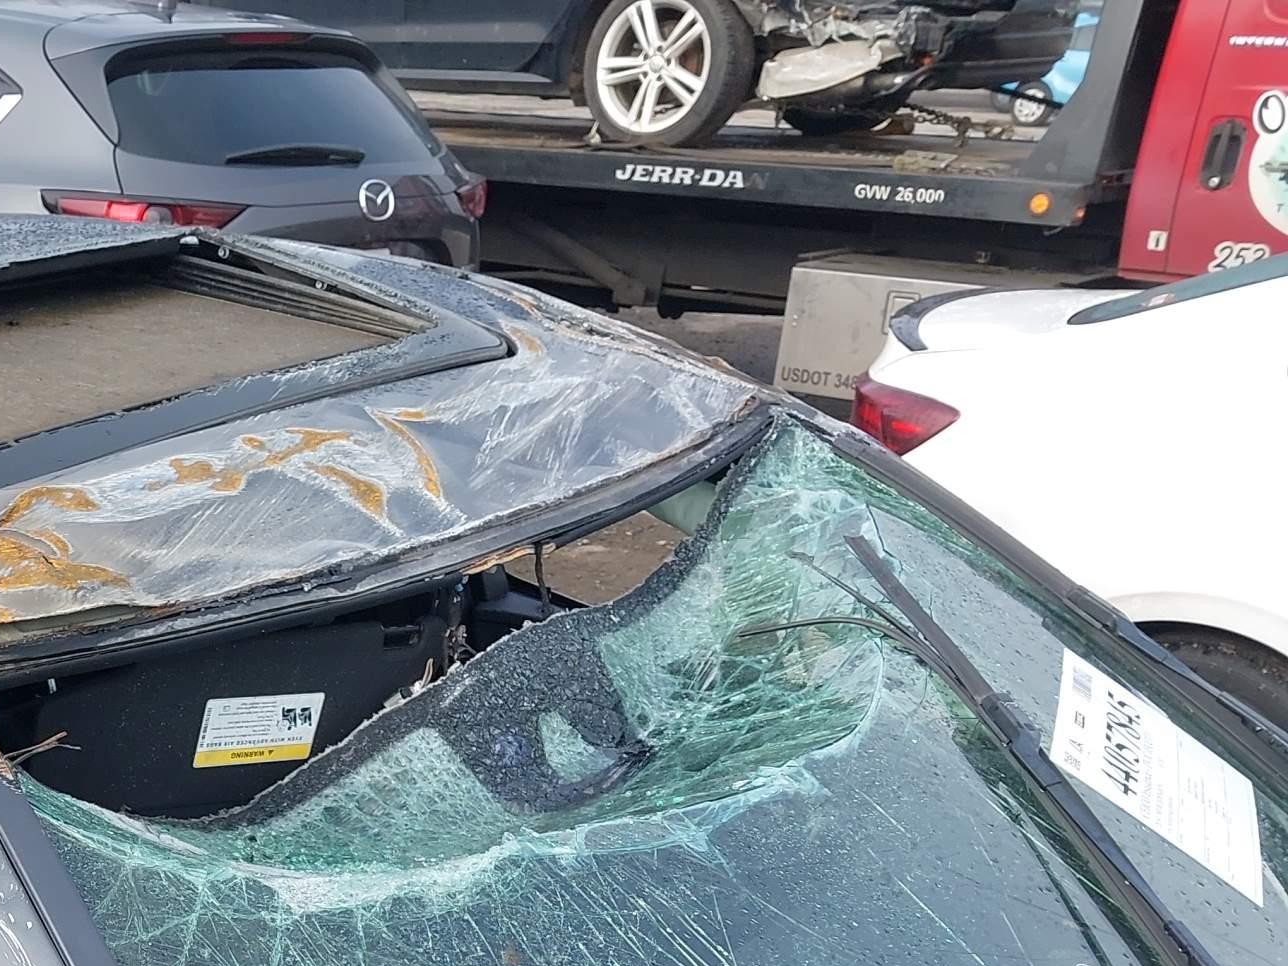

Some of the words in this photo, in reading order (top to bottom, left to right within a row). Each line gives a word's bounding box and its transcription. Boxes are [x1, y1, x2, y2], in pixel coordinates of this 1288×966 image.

[854, 184, 891, 201] GVW
[895, 186, 945, 204] 26,000
[781, 366, 832, 386] USDOT
[1101, 690, 1141, 796] 44057845
[231, 751, 265, 759] WARNING
